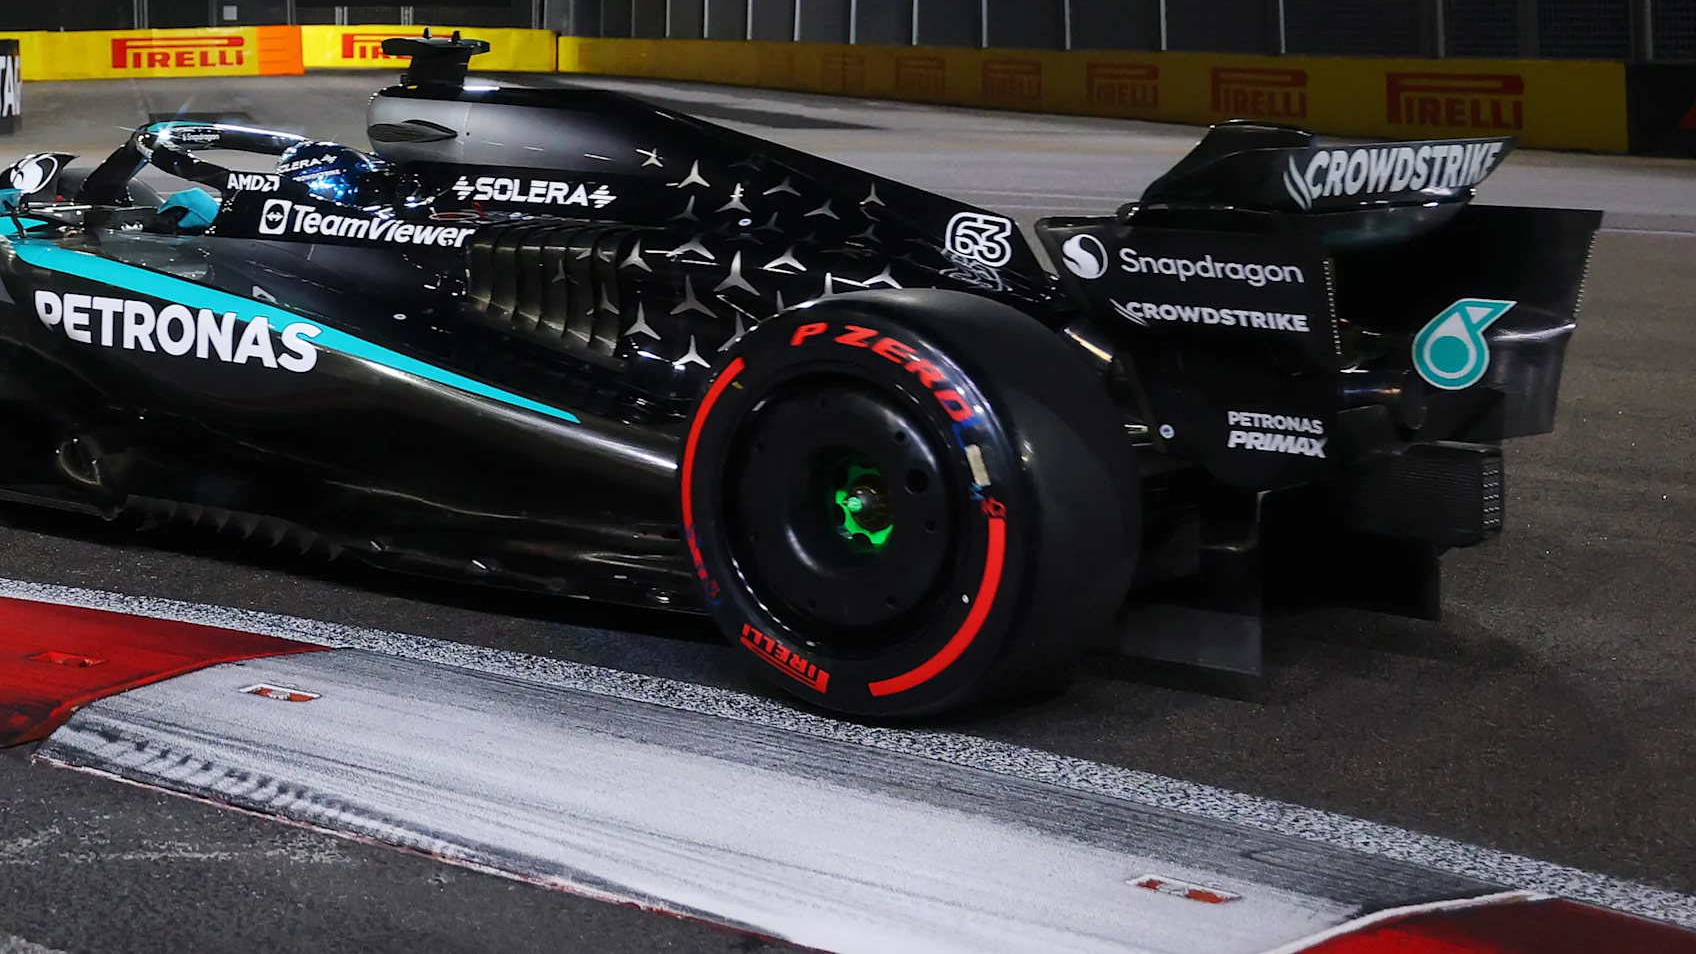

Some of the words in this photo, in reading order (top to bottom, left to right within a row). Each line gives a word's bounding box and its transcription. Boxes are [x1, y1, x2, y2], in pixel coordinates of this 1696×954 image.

[112, 36, 244, 69] PIRELLI
[1210, 67, 1308, 118] PIRELLI
[1386, 72, 1524, 129] PIRELLI
[226, 173, 263, 191] AMD
[474, 176, 592, 208] SOLERA
[1304, 141, 1504, 201] CROWDSTRIKE
[292, 203, 476, 248] TeamViewer
[945, 211, 1013, 267] 63
[1118, 247, 1305, 288] Snapdragon
[34, 289, 323, 374] PETRONAS
[1127, 300, 1310, 333] CROWDSTRIKE
[790, 321, 830, 347] P
[833, 324, 975, 423] ZERO
[1226, 429, 1327, 459] PRIMAX
[1227, 410, 1324, 436] PETRONAS
[740, 623, 831, 695] PIRELLI
